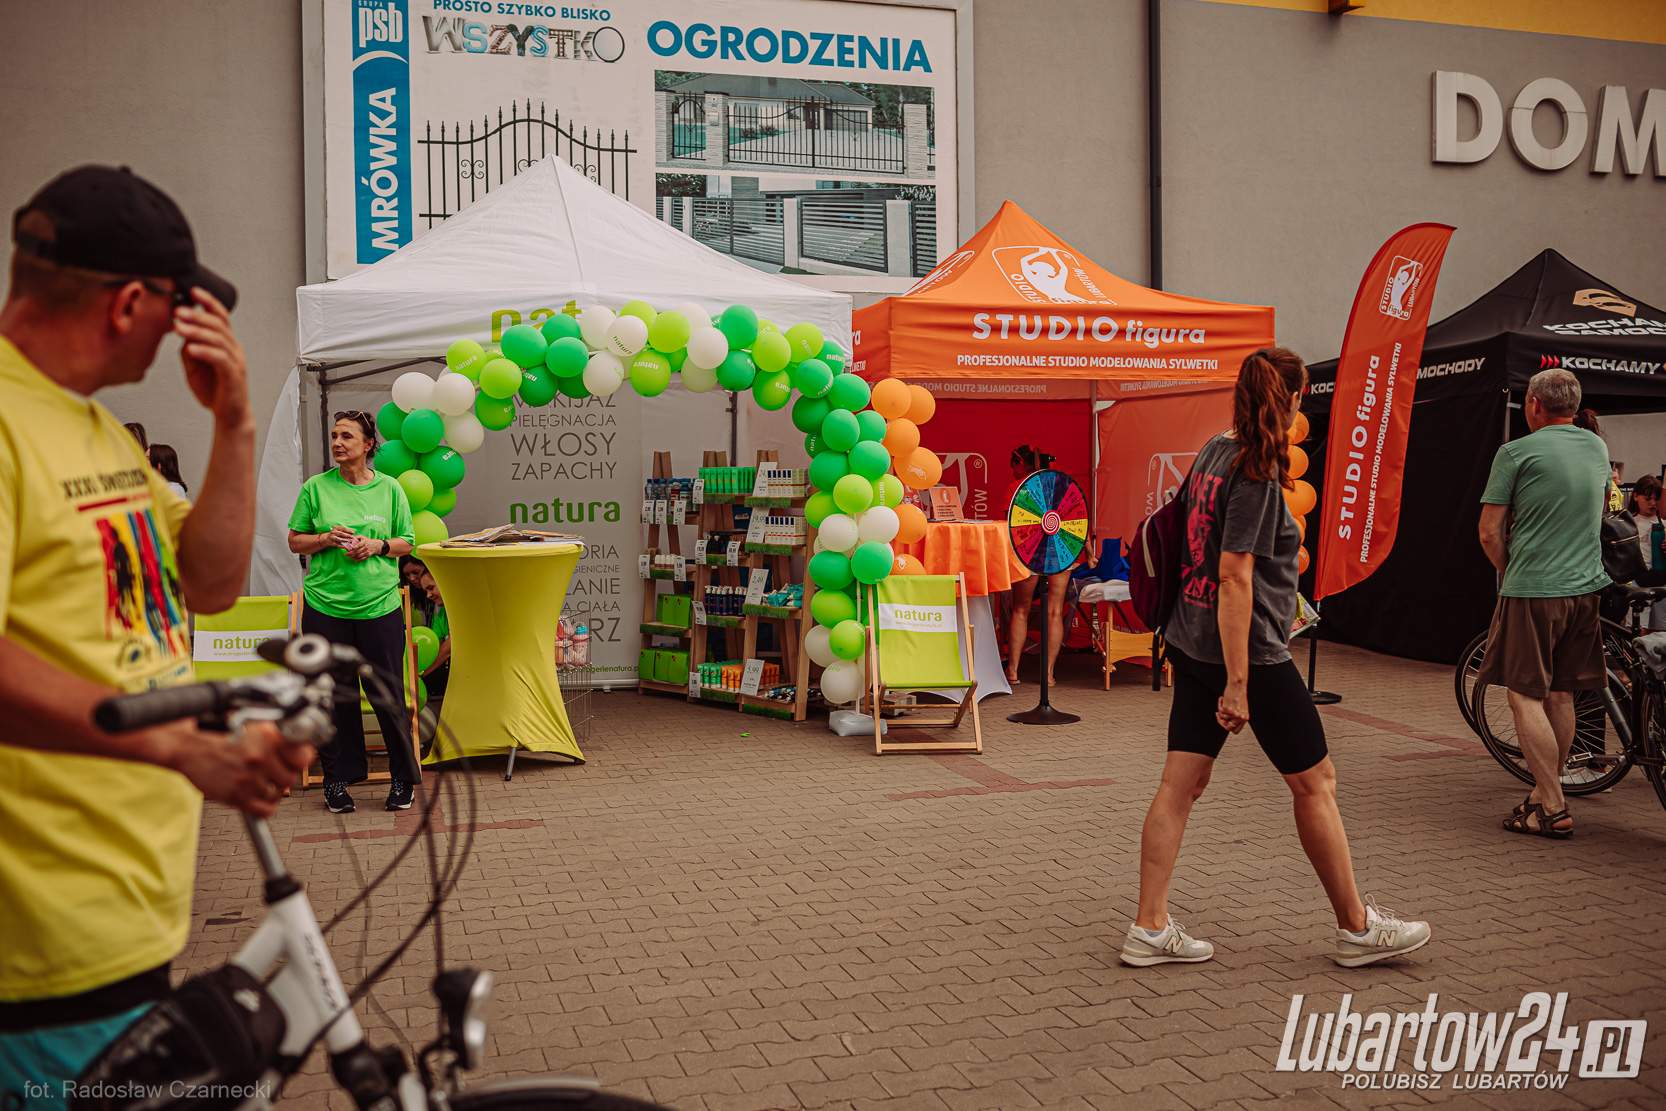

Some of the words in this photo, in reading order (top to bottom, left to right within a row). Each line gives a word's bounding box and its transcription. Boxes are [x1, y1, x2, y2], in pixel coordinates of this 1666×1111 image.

[359, 2, 403, 48] psb
[433, 0, 491, 13] PROSTO
[497, 3, 556, 17] SZYBKO
[561, 8, 611, 21] BLISKO
[422, 15, 625, 63] WSZYSTKO
[647, 20, 933, 73] OGRODZENIA
[1432, 70, 1666, 178] DOM
[361, 87, 400, 250] MRÓWKA
[972, 313, 1119, 342] STUDIO
[1125, 320, 1206, 348] figura
[957, 354, 1046, 367] PROFESJONALNE
[1048, 356, 1087, 368] STUDIO
[1089, 357, 1167, 369] MODELOWANIA
[1169, 359, 1218, 370] SYLWETKI
[1387, 342, 1402, 387] SYLWETKI
[1416, 358, 1486, 379] MOCHODY
[1562, 356, 1661, 375] KOCHAMY
[1375, 387, 1394, 454] MODELOWANIA
[511, 432, 616, 456] WŁOSY
[1338, 425, 1367, 540] STUDIO
[1356, 355, 1380, 421] figura
[511, 462, 617, 480] ZAPACHY
[1371, 455, 1381, 489] STUDIO
[510, 498, 620, 523] natura
[1360, 489, 1377, 563] PROFESJONALNE
[577, 600, 620, 613] CIAŁA
[895, 607, 943, 622] natura
